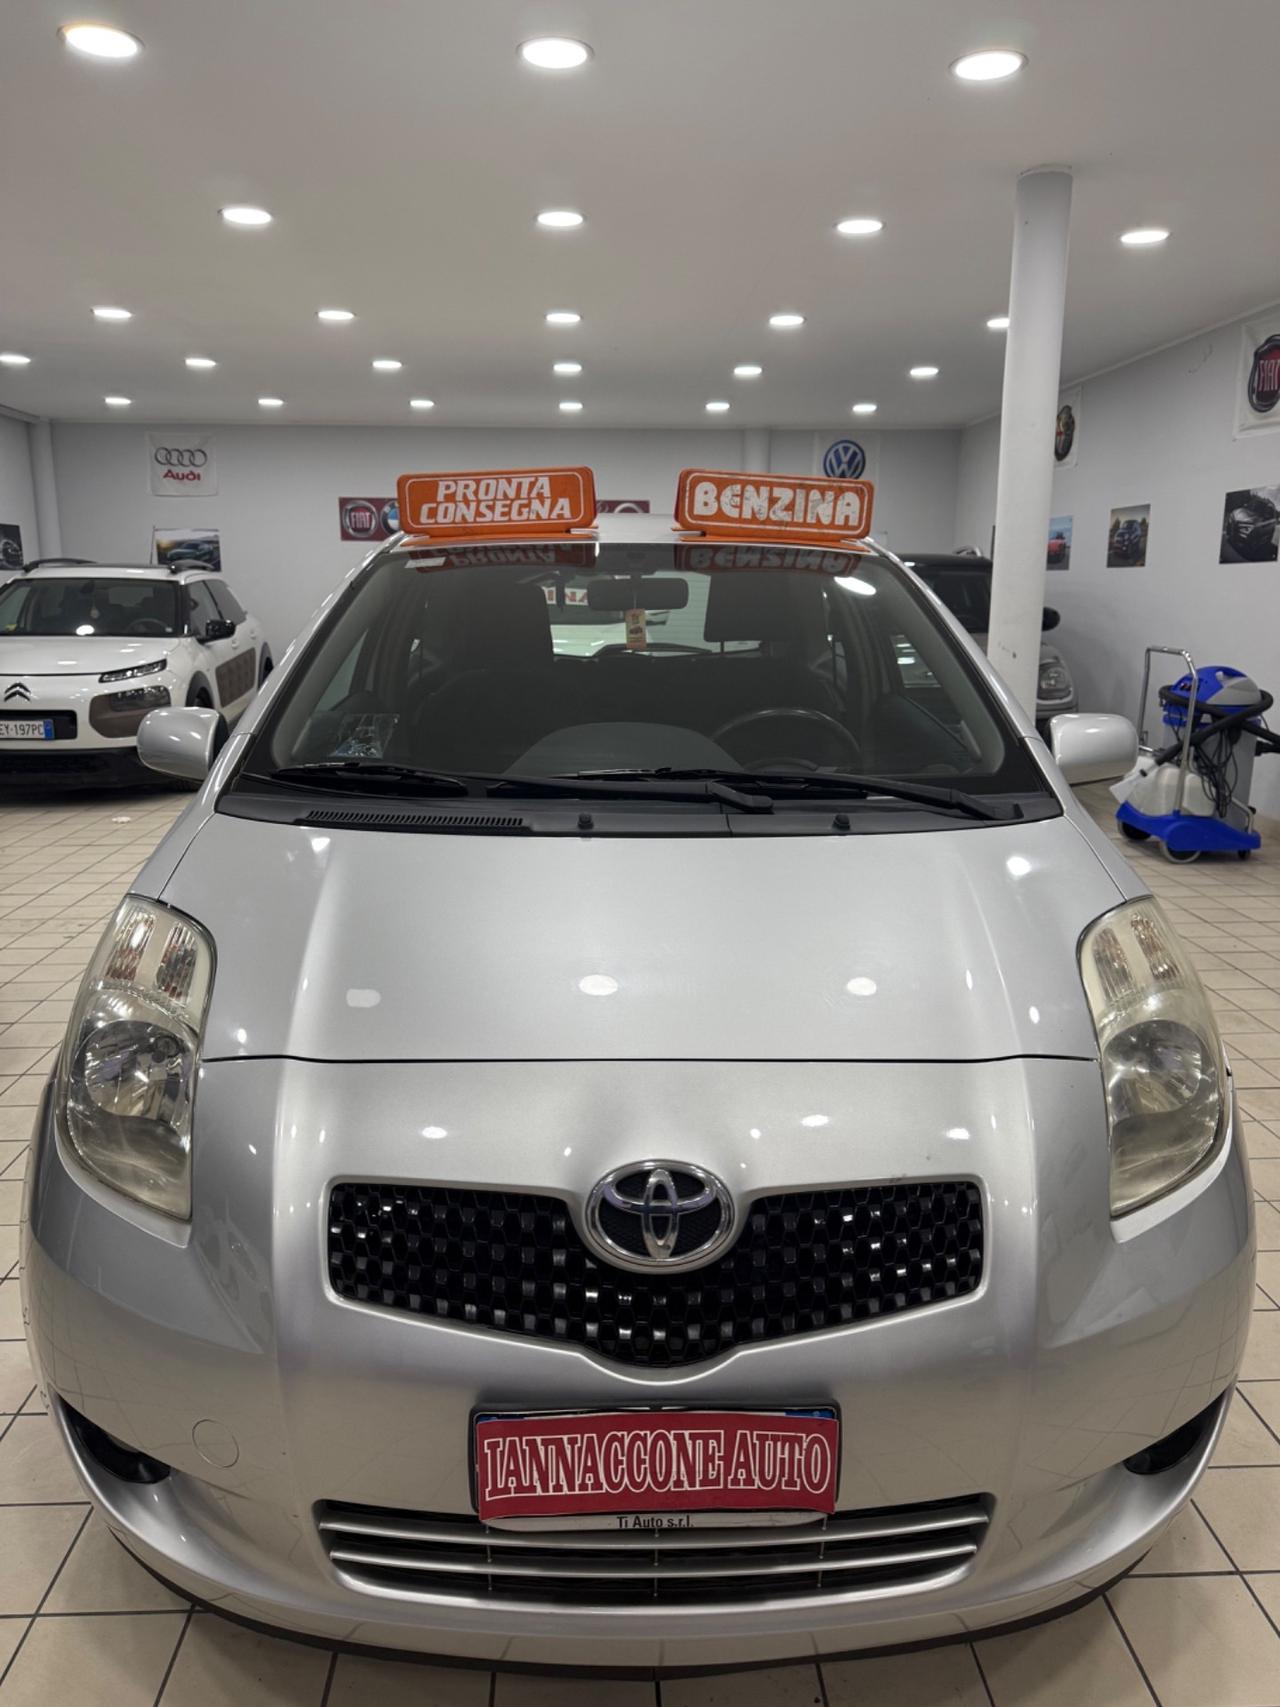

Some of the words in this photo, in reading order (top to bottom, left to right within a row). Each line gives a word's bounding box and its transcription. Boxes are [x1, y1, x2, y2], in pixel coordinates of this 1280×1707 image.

[163, 469, 201, 481] Audi
[437, 476, 552, 501] PRONTA
[420, 498, 572, 524] CONSEGNA
[693, 481, 861, 526] BENZINA
[350, 511, 371, 529] FIAT
[484, 1430, 725, 1501] IANNACCONE
[728, 1430, 832, 1494] AUTO
[617, 1516, 629, 1528] Ti
[633, 1516, 664, 1528] Auto
[667, 1515, 695, 1528] s.r.l.
